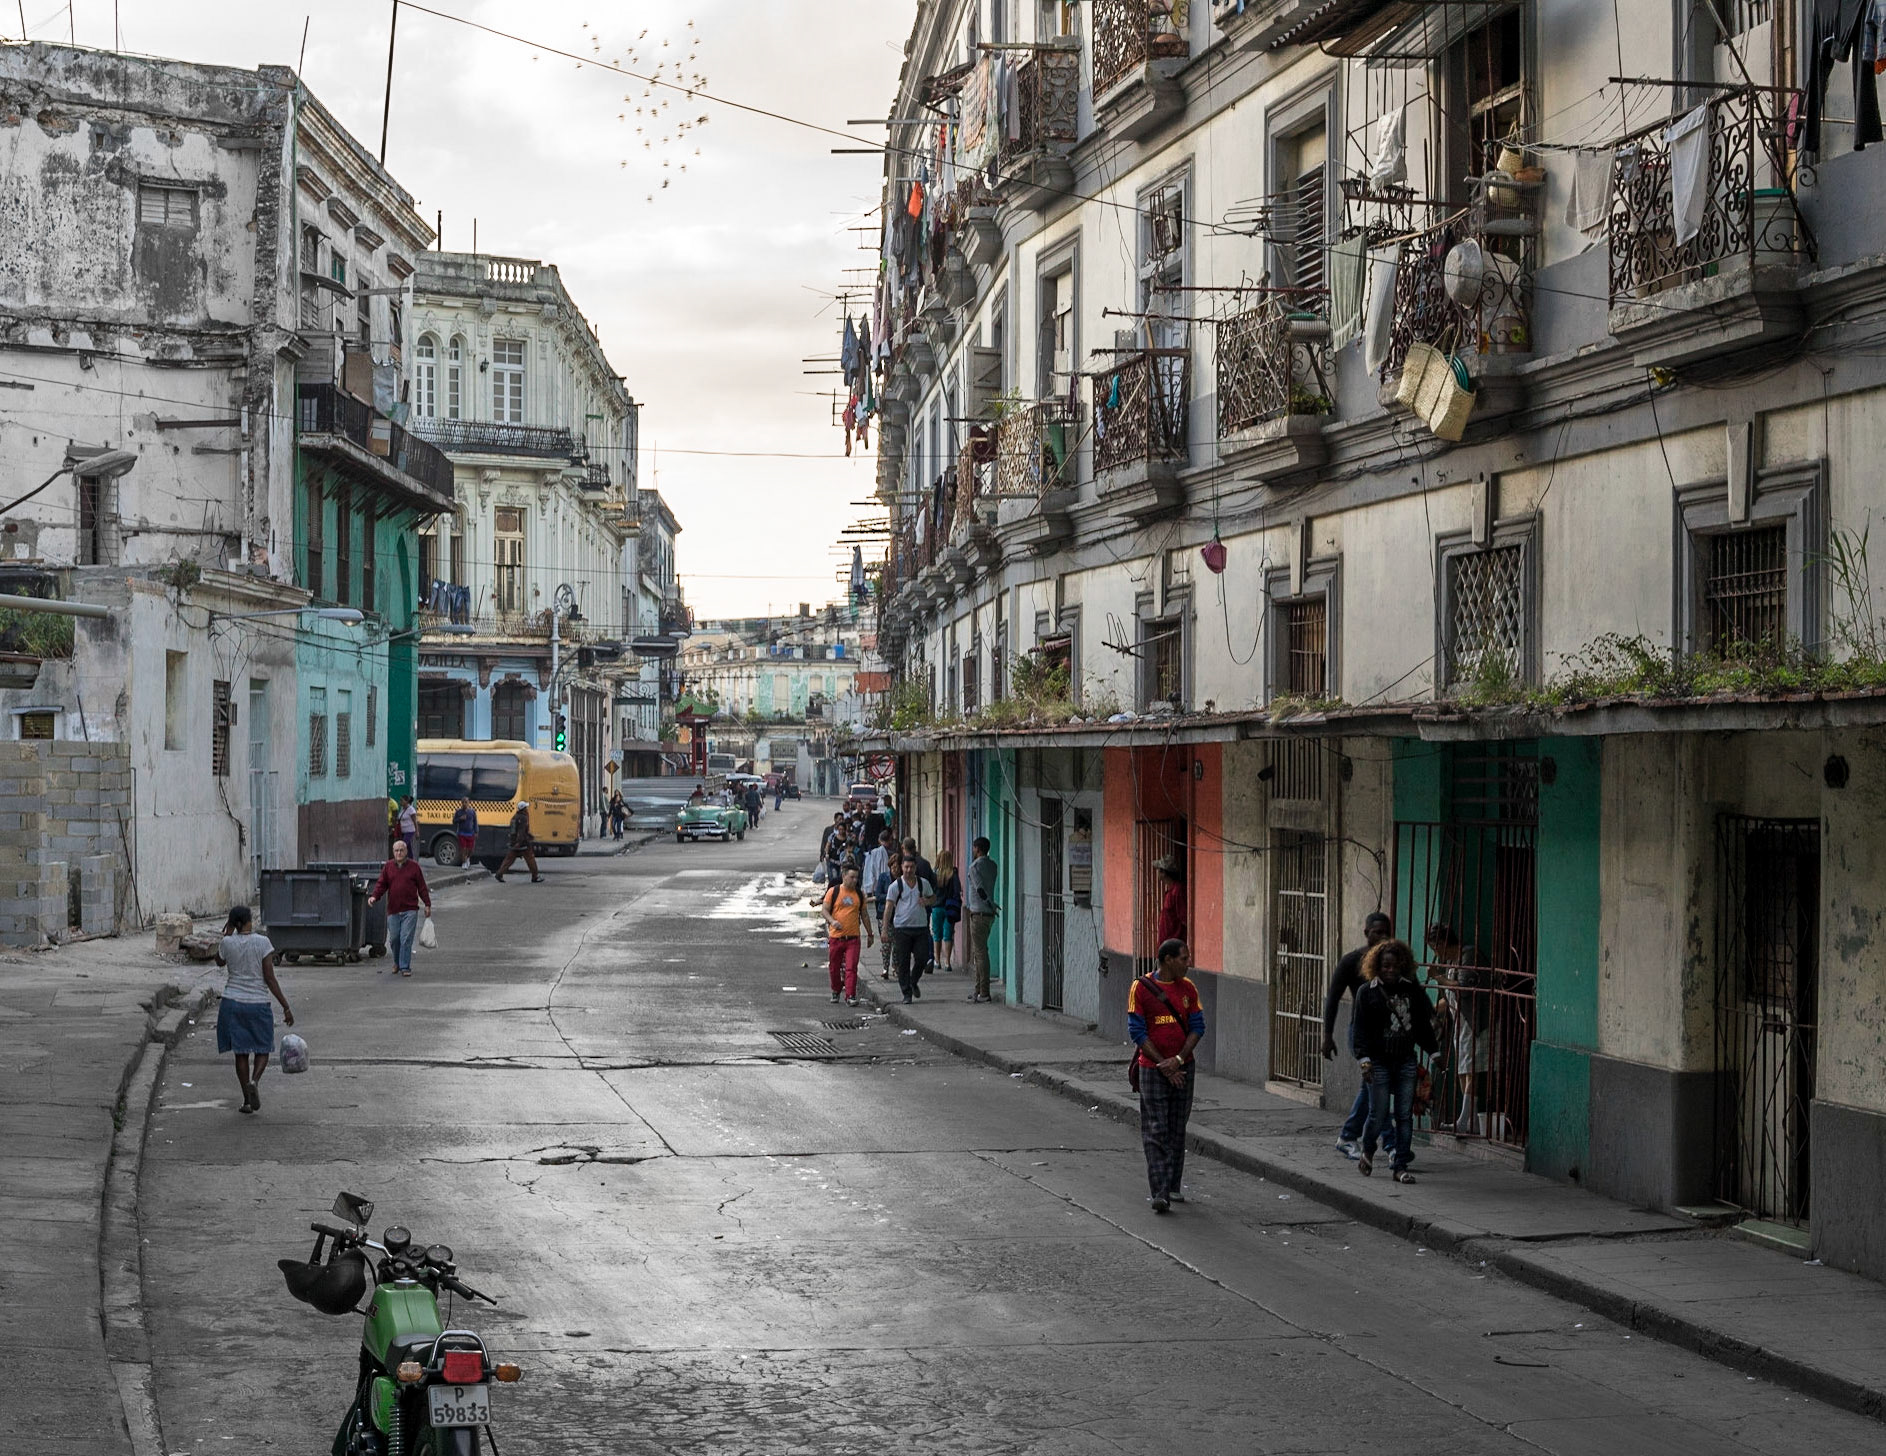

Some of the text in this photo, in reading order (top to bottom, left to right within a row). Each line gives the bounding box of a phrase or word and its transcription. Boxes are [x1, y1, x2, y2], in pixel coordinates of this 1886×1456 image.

[1154, 1014, 1177, 1025] ESPA
[454, 1387, 465, 1404] P
[434, 1405, 488, 1424] 59833
